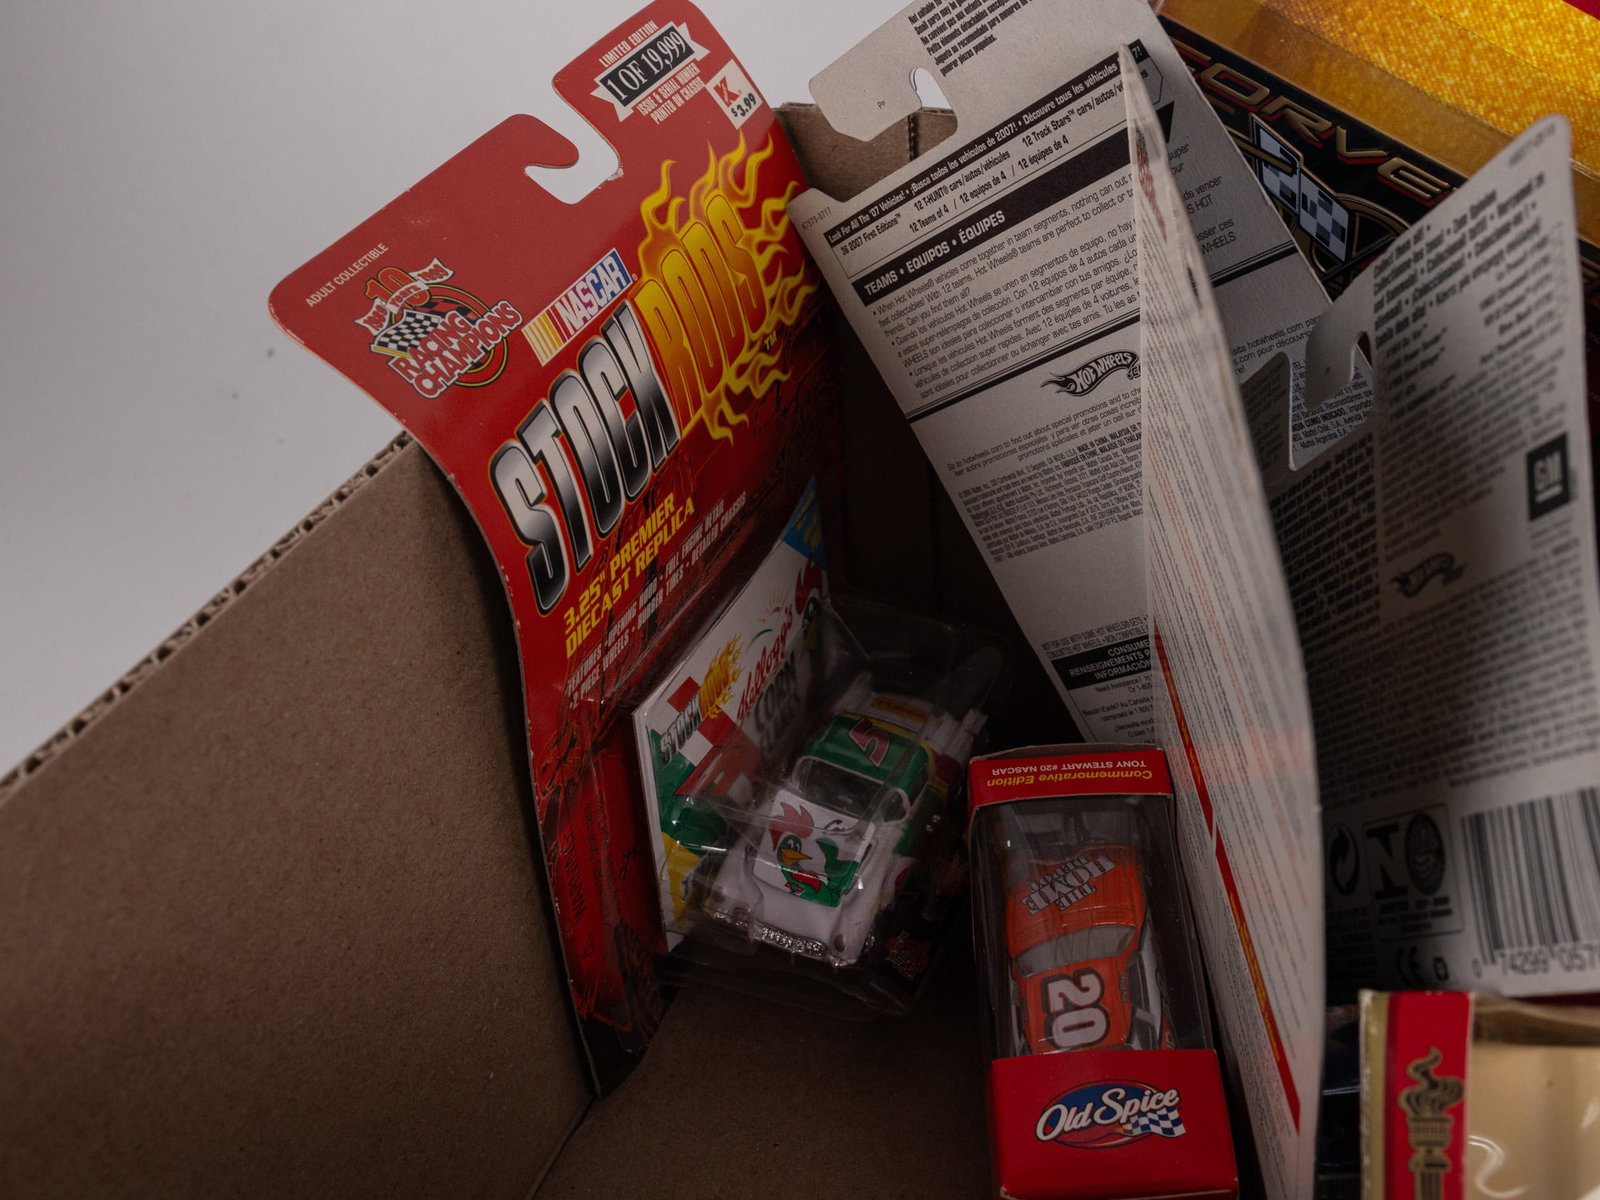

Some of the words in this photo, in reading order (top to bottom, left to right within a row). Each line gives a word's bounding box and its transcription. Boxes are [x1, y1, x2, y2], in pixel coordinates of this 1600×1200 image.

[598, 40, 632, 68] LIMITED
[627, 20, 659, 46] EDITION
[606, 78, 628, 100] 1
[618, 59, 648, 90] OF
[640, 30, 686, 75] 19,999
[635, 96, 658, 116] ISSUE
[657, 78, 681, 99] SERIAL
[649, 99, 677, 124] PRINTED
[671, 93, 685, 107] ON
[679, 76, 707, 101] CHASSIS
[731, 93, 757, 117] $3.99
[1021, 134, 1034, 147] 12
[1030, 124, 1053, 142] Track
[1076, 79, 1124, 116] cars/autos/v
[840, 225, 851, 236] For
[850, 218, 860, 230] All
[857, 213, 870, 224] The
[878, 189, 906, 211] Vehicles!
[910, 176, 931, 195] ¡Busca
[929, 165, 949, 181] todos
[946, 159, 959, 170] los
[986, 136, 996, 147] de
[994, 121, 1018, 142] 2007!
[1022, 100, 1056, 125] Découvre
[1054, 90, 1073, 105] tous
[1071, 83, 1084, 95] les
[1083, 63, 1118, 88] véhicules
[1017, 157, 1029, 170] 12
[1027, 145, 1054, 165] équipes
[1052, 139, 1063, 151] de
[1062, 134, 1069, 144] 4
[913, 199, 924, 211] 12
[959, 192, 970, 204] 12
[969, 181, 993, 199] equipos
[991, 175, 1001, 186] de
[1000, 170, 1007, 180] 4
[1194, 174, 1223, 196] vencer
[1196, 194, 1214, 211] HOT
[862, 229, 878, 242] First
[909, 221, 919, 233] 12
[916, 213, 937, 229] Teams
[936, 206, 944, 218] of
[942, 203, 949, 213] 4
[933, 266, 960, 284] vehicles
[959, 256, 978, 271] come
[976, 241, 1005, 261] together
[1005, 236, 1015, 246] in
[1013, 227, 1033, 242] team
[1032, 208, 1071, 232] segments,
[1070, 191, 1100, 212] nothing
[1098, 184, 1114, 197] can
[1114, 175, 1129, 189] out
[941, 282, 952, 294] 12
[951, 273, 975, 290] teams,
[973, 265, 988, 278] Hot
[1017, 237, 1042, 254] teams
[1041, 230, 1055, 242] are
[1055, 215, 1082, 238] perfect
[1081, 211, 1091, 221] to
[1091, 197, 1117, 216] collect
[1116, 192, 1126, 203] or
[1219, 219, 1235, 234] ces
[305, 281, 336, 307] ADULT
[333, 242, 389, 285] COLLECTIBLE
[863, 270, 898, 295] TEAMS
[905, 241, 950, 273] EQUIPOS
[958, 209, 1005, 244] ÉQUIPES
[992, 287, 1002, 297] se
[1001, 278, 1020, 292] unen
[1019, 272, 1030, 283] en
[1029, 253, 1069, 278] segmentos
[1068, 247, 1079, 258] de
[1079, 235, 1107, 253] equipo,
[1106, 228, 1118, 239] no
[1116, 220, 1133, 233] hay
[1012, 288, 1029, 300] Con
[1027, 280, 1040, 292] 12
[1040, 268, 1068, 287] equipos
[1067, 262, 1078, 273] de
[1078, 257, 1086, 267] 4
[1086, 248, 1108, 264] autos
[1107, 238, 1128, 254] cada
[553, 255, 628, 337] NASCAR
[387, 310, 472, 383] RACING
[412, 300, 524, 399] CHAMPIONS
[488, 299, 681, 615] STOCK
[630, 192, 772, 441] RODS
[1108, 393, 1122, 405] and
[1121, 392, 1130, 400] to
[563, 570, 605, 634] 3.25"
[609, 492, 675, 581] PREMIER
[665, 551, 679, 579] FULL
[681, 523, 704, 559] ENGINE
[565, 566, 631, 659] DIECAST
[634, 497, 694, 577] REPLICA
[580, 663, 600, 700] PIECE
[602, 628, 629, 672] WHEELS
[849, 718, 891, 768] 5
[1061, 762, 1114, 771] STEWART
[1115, 760, 1147, 769] TONY
[985, 775, 1035, 788] Edition
[992, 766, 1039, 776] NASCAR
[1038, 770, 1153, 783] Commemorative
[1054, 882, 1097, 911] THE
[1041, 966, 1111, 1050] 20
[1036, 1102, 1094, 1141] Old
[1093, 1087, 1180, 1126] Spice
